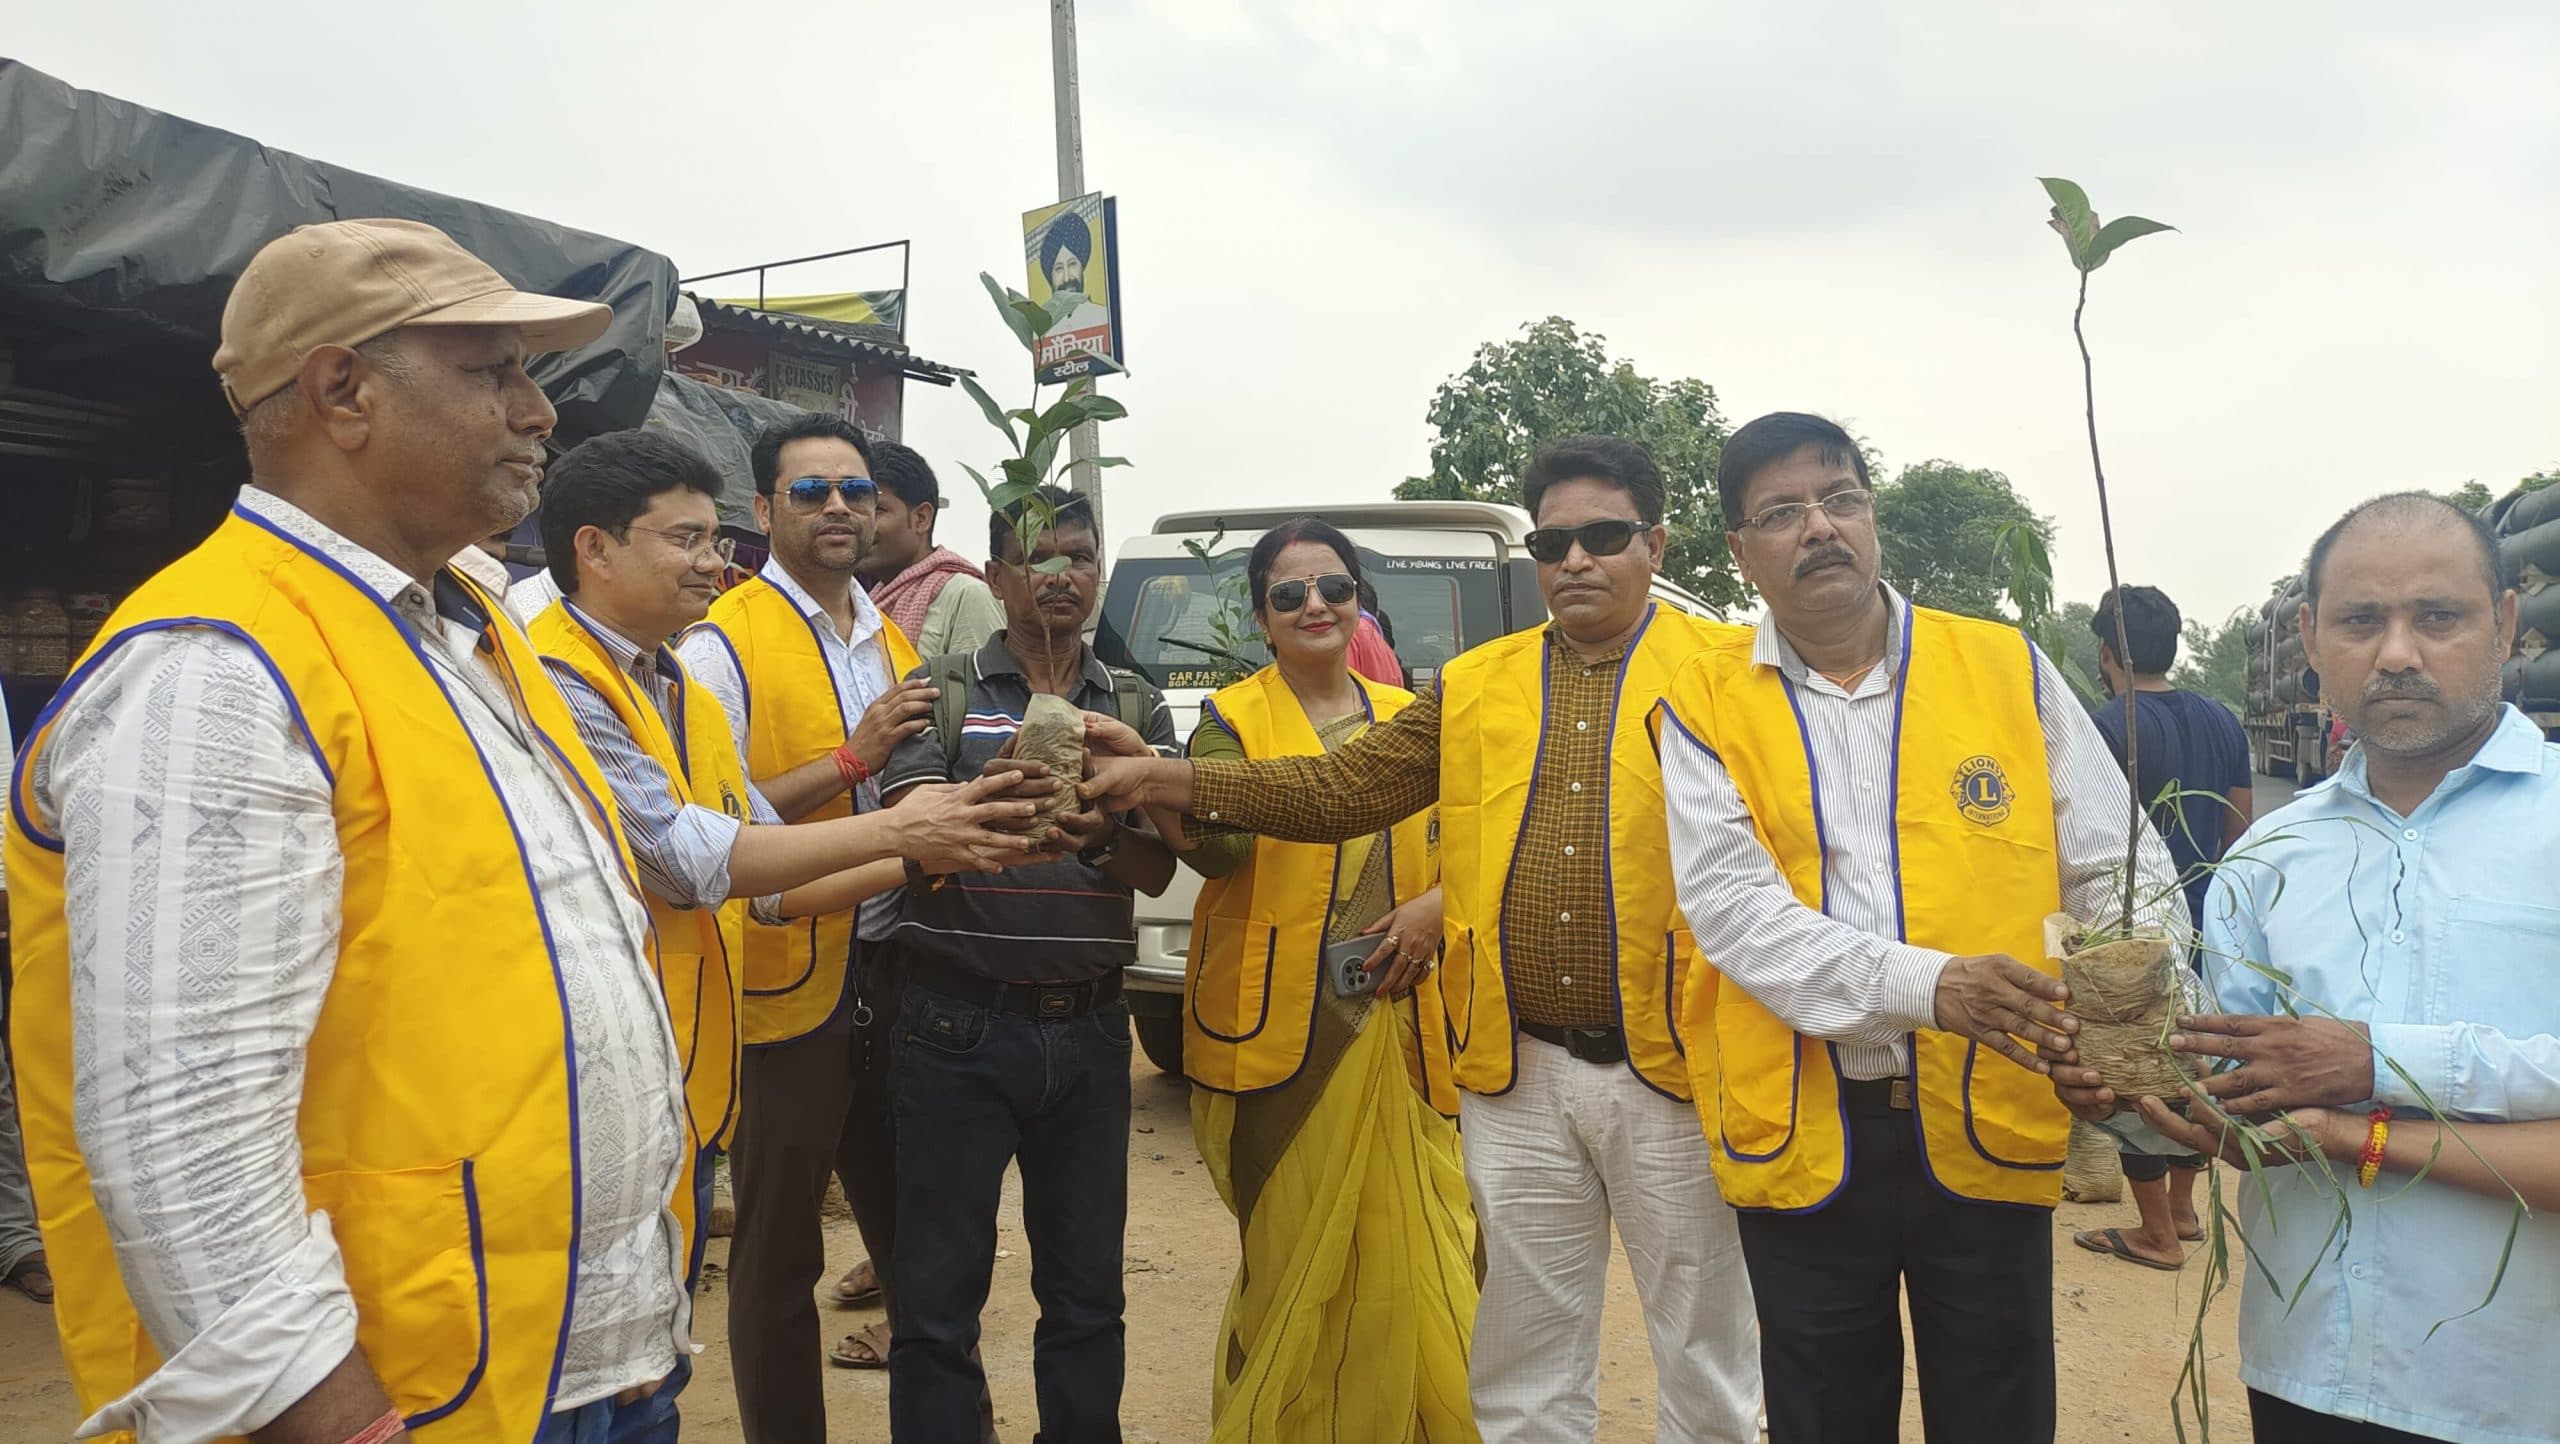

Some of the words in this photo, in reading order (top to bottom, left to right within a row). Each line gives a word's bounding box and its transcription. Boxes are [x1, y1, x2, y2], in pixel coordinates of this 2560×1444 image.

[1053, 361, 1090, 377] स्टील
[785, 365, 833, 395] CLASSES
[1386, 560, 1407, 569] LIVE
[1446, 560, 1467, 570] LIVE
[1469, 561, 1495, 570] FREE
[1168, 671, 1193, 681] CAR
[1963, 758, 2000, 774] LIONS
[1978, 777, 1997, 801] L
